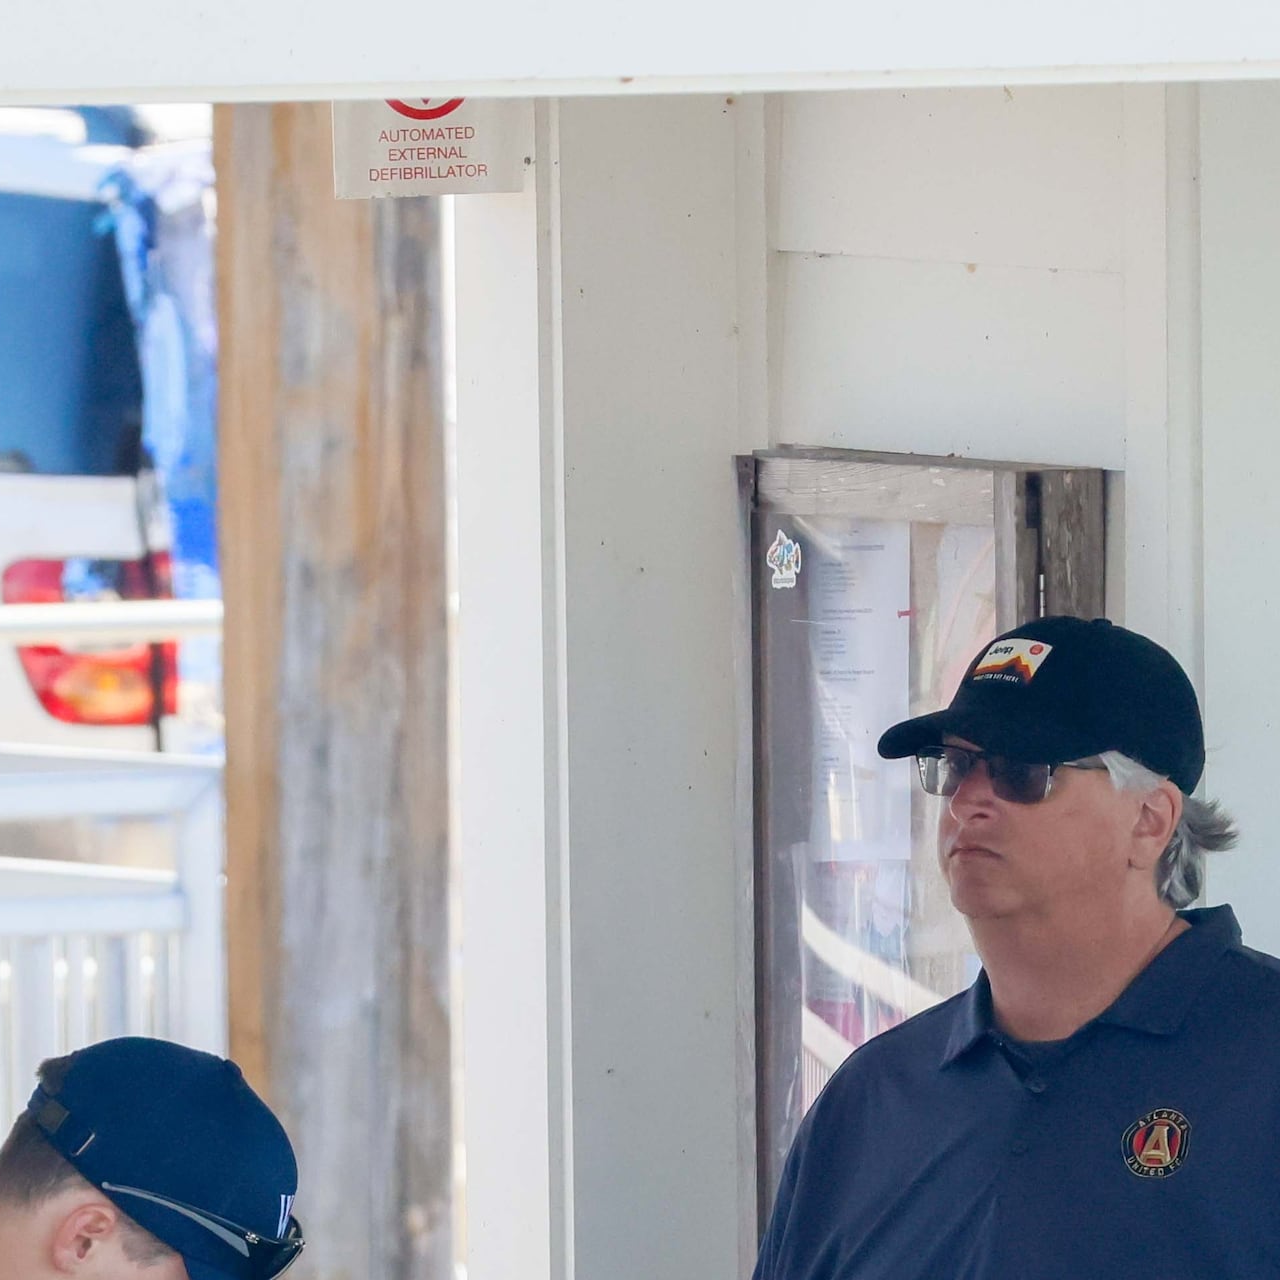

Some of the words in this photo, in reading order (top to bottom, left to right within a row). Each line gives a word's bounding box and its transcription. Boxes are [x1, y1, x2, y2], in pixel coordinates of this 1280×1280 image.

[379, 126, 475, 143] AUTOMATED
[389, 147, 467, 161] EXTERNAL
[369, 164, 488, 182] DEFIBRILLATOR
[1138, 1111, 1187, 1130] ATLANTA
[1127, 1156, 1164, 1176] UNITED
